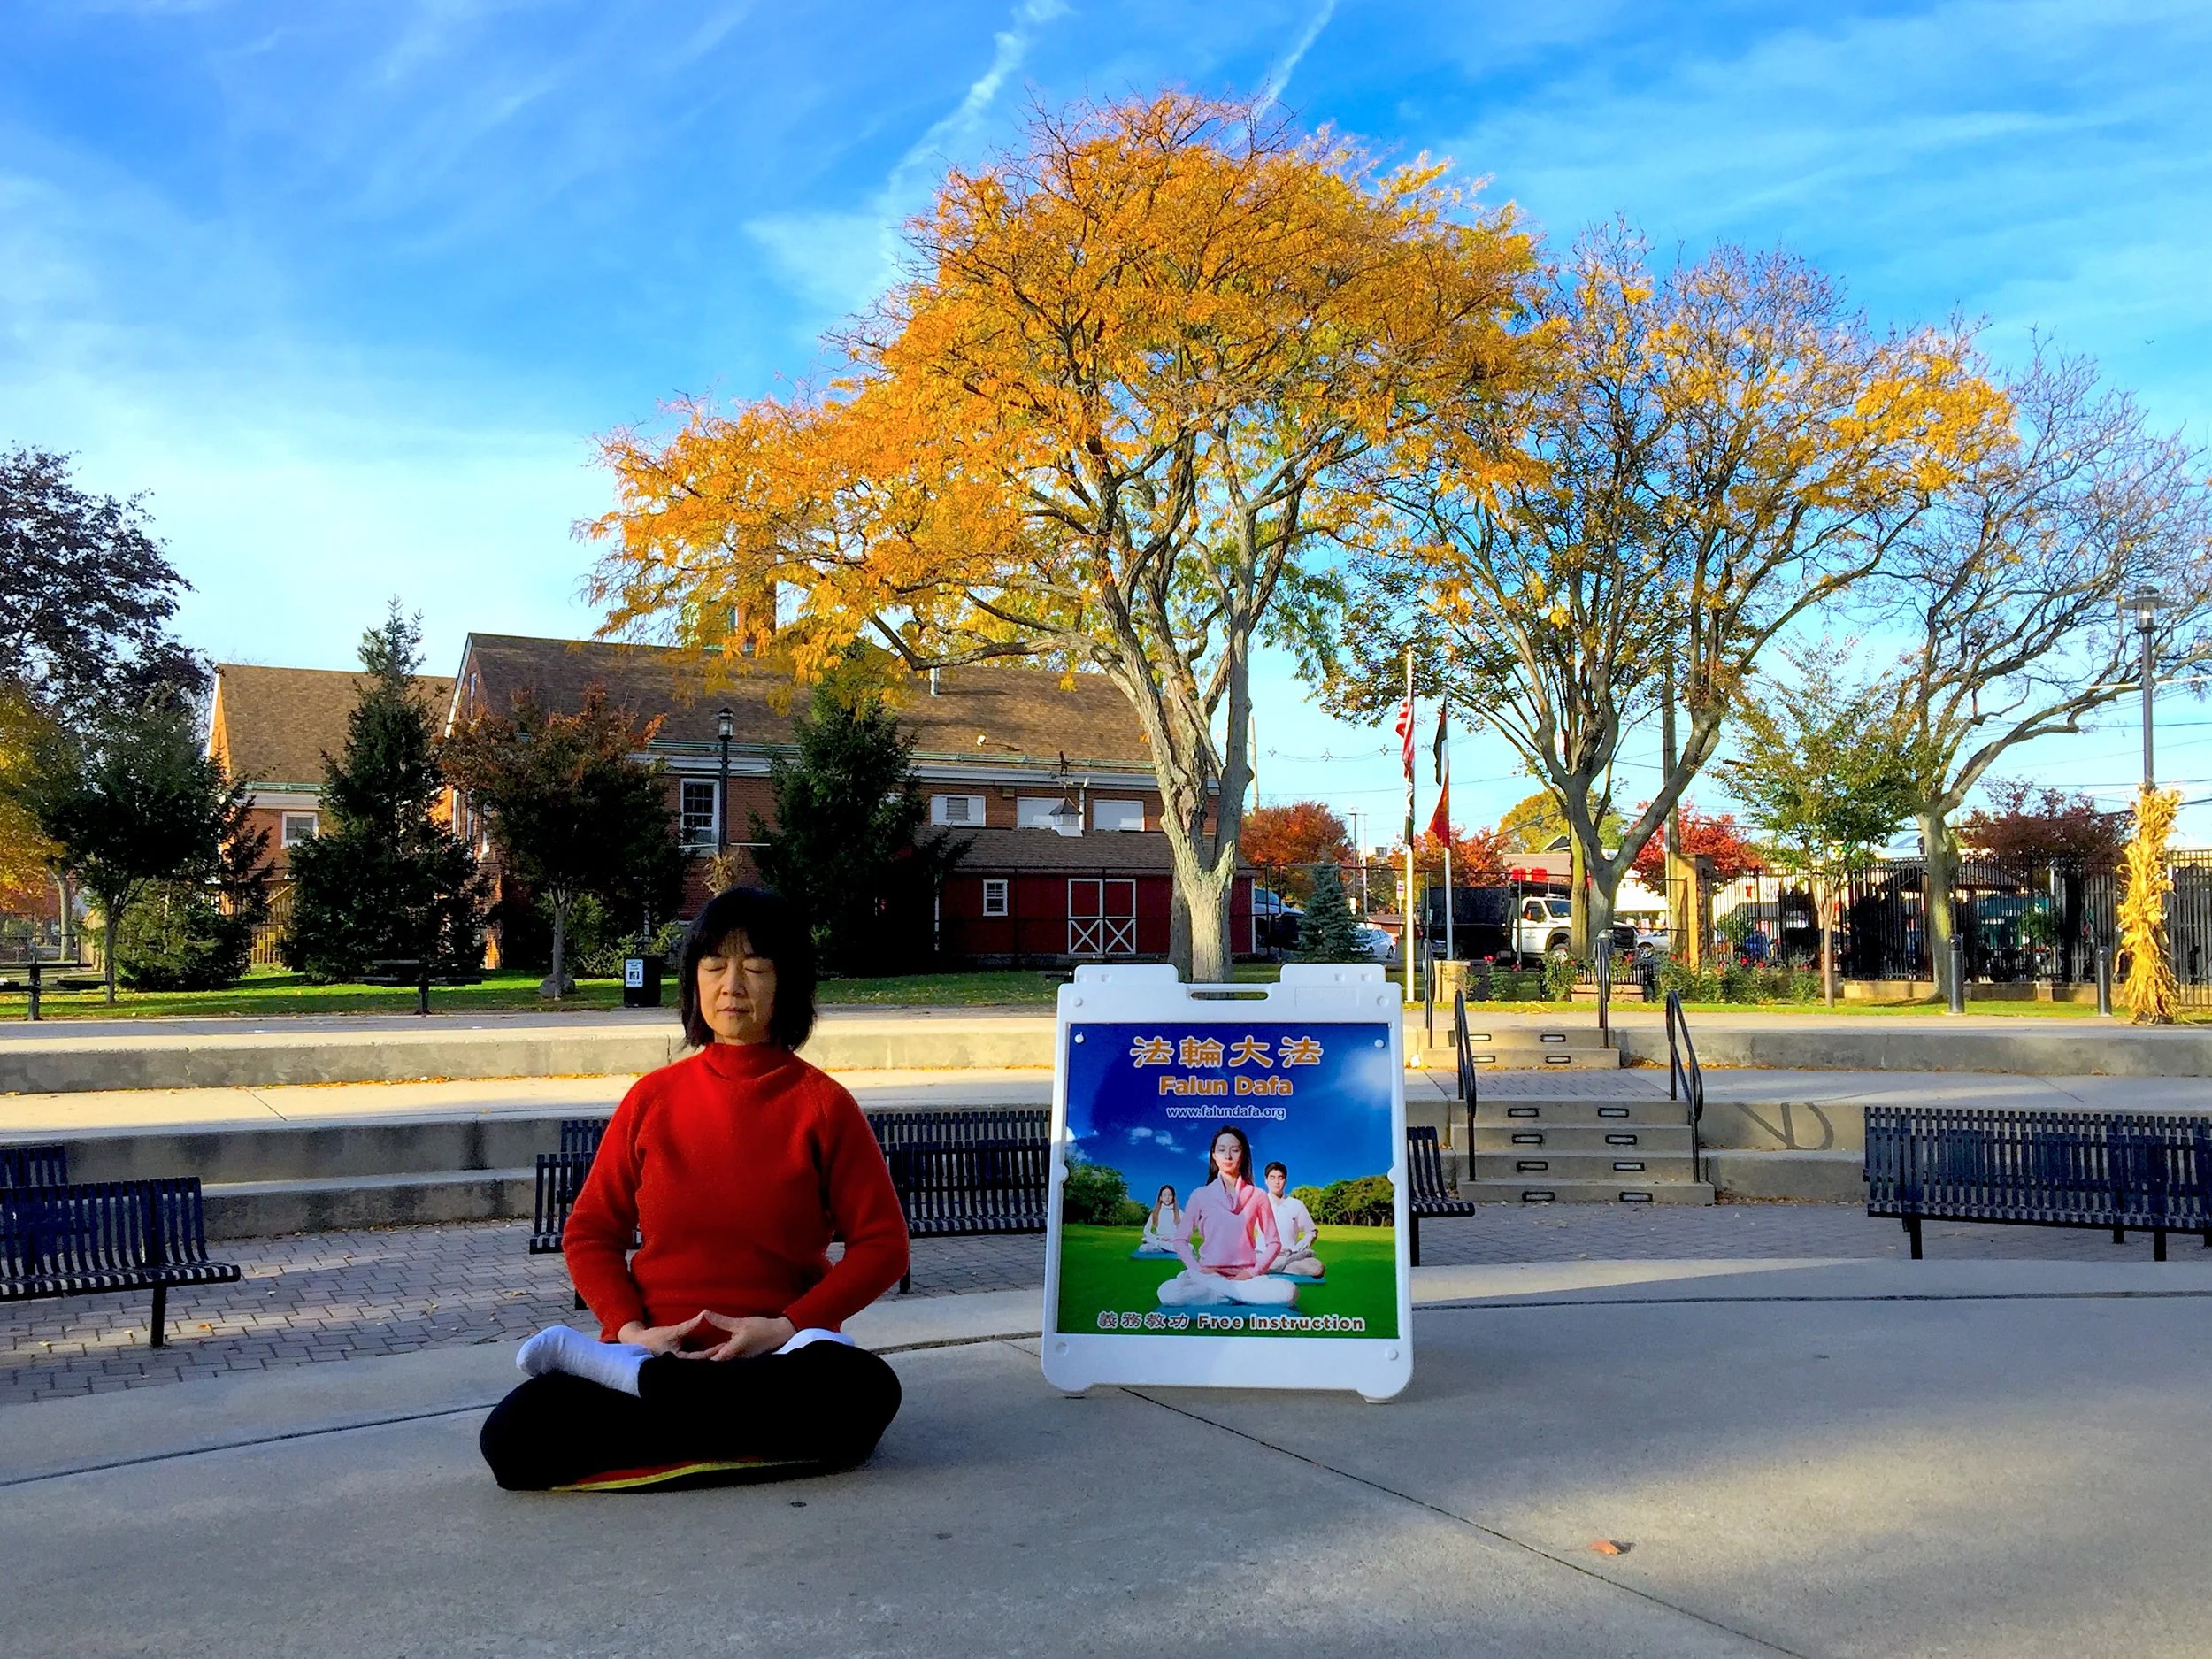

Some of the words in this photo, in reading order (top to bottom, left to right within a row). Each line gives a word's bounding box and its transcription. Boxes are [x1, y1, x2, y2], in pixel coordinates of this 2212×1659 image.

[1130, 1035, 1323, 1068] 法輪大法
[1159, 1075, 1228, 1096] Falun
[1234, 1076, 1294, 1096] Dafa
[1165, 1104, 1286, 1120] www.falundafa.org
[1097, 1310, 1190, 1330] 義務教功
[1197, 1313, 1244, 1329] Free
[1249, 1313, 1365, 1332] Instruction
